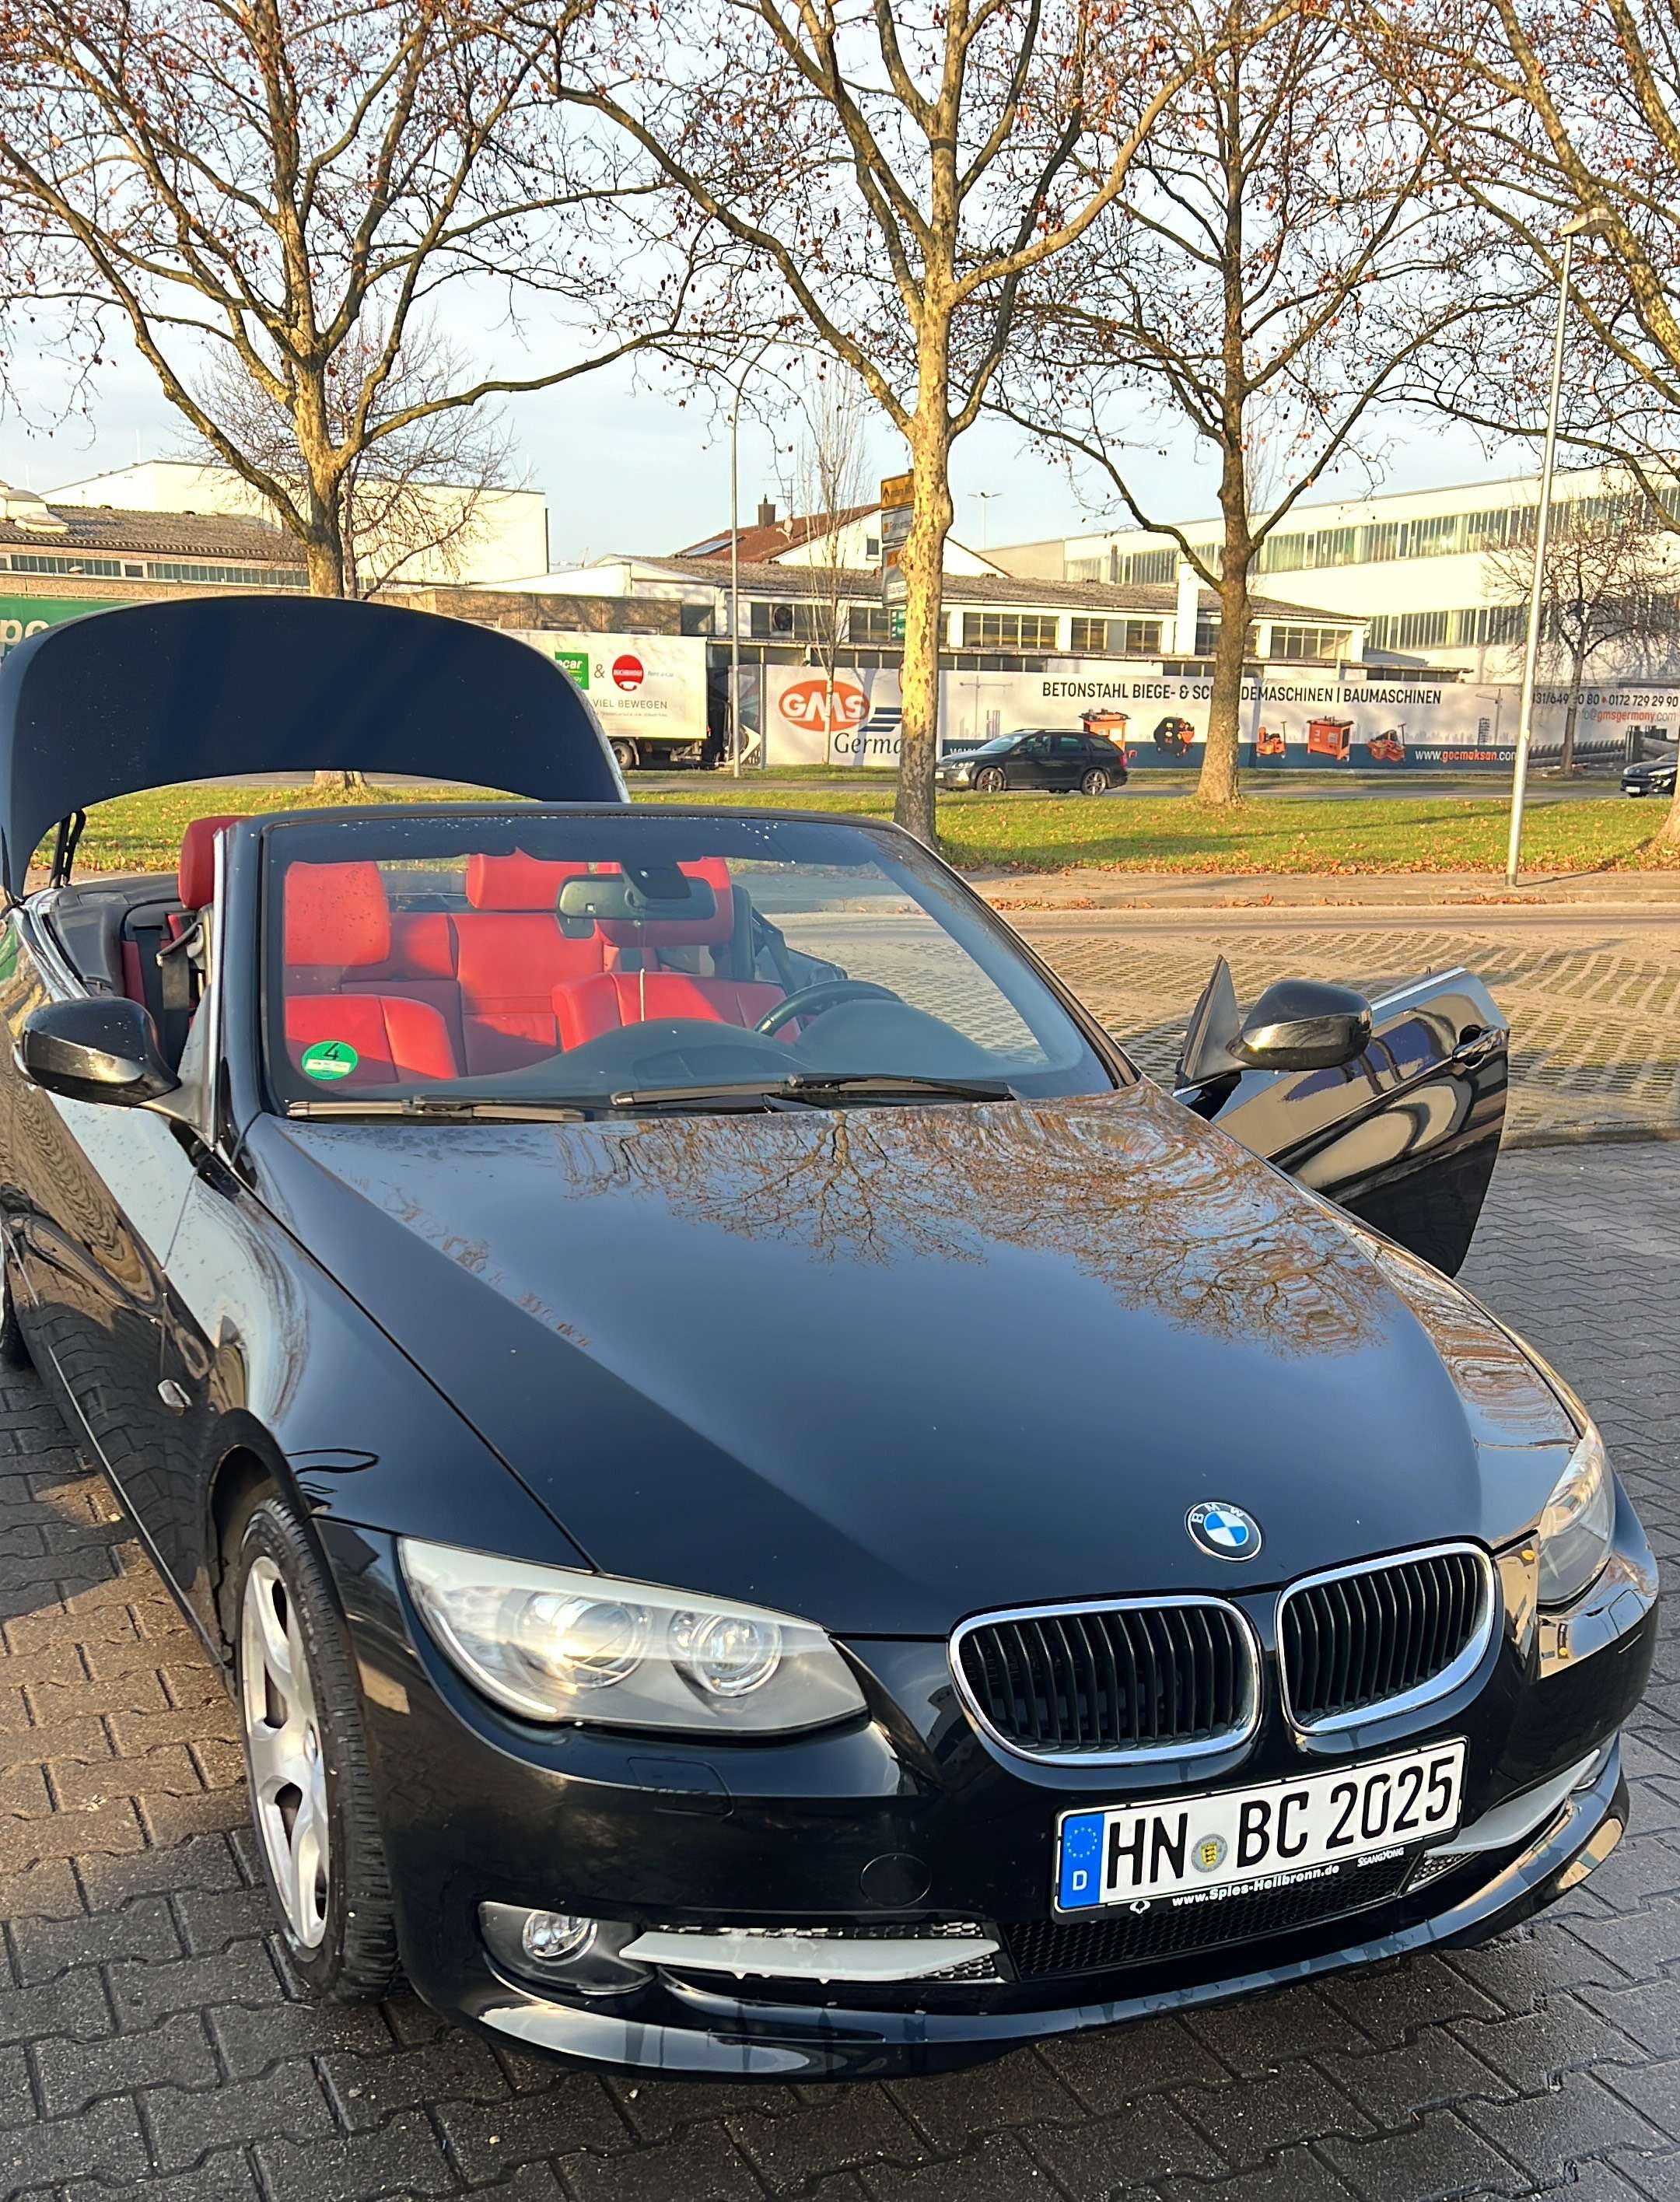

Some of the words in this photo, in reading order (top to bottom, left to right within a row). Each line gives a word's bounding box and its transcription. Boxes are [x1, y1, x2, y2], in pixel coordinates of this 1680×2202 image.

[593, 663, 605, 679] &
[1042, 681, 1129, 698] BETONSTAHL
[1132, 684, 1175, 699] BIEGE-
[1179, 684, 1189, 699] &
[1344, 688, 1441, 704] BAUMASCHINEN
[1587, 694, 1599, 705] 80
[1608, 695, 1629, 706] 0172
[1633, 695, 1650, 707] 729
[1651, 696, 1665, 707] 29
[1667, 696, 1679, 708] 90
[593, 699, 614, 708] VIEL
[618, 699, 667, 709] BEWEGEN
[782, 691, 865, 723] GMS
[834, 733, 902, 754] Germa
[324, 1043, 339, 1060] 4
[1192, 1504, 1245, 1524] BMW
[1107, 1813, 1188, 1889] HN
[1236, 1791, 1310, 1868] BC
[1325, 1756, 1454, 1850] 2025
[1073, 1869, 1087, 1891] D
[1172, 1864, 1340, 1906] www.Spies-Heilbronn.de
